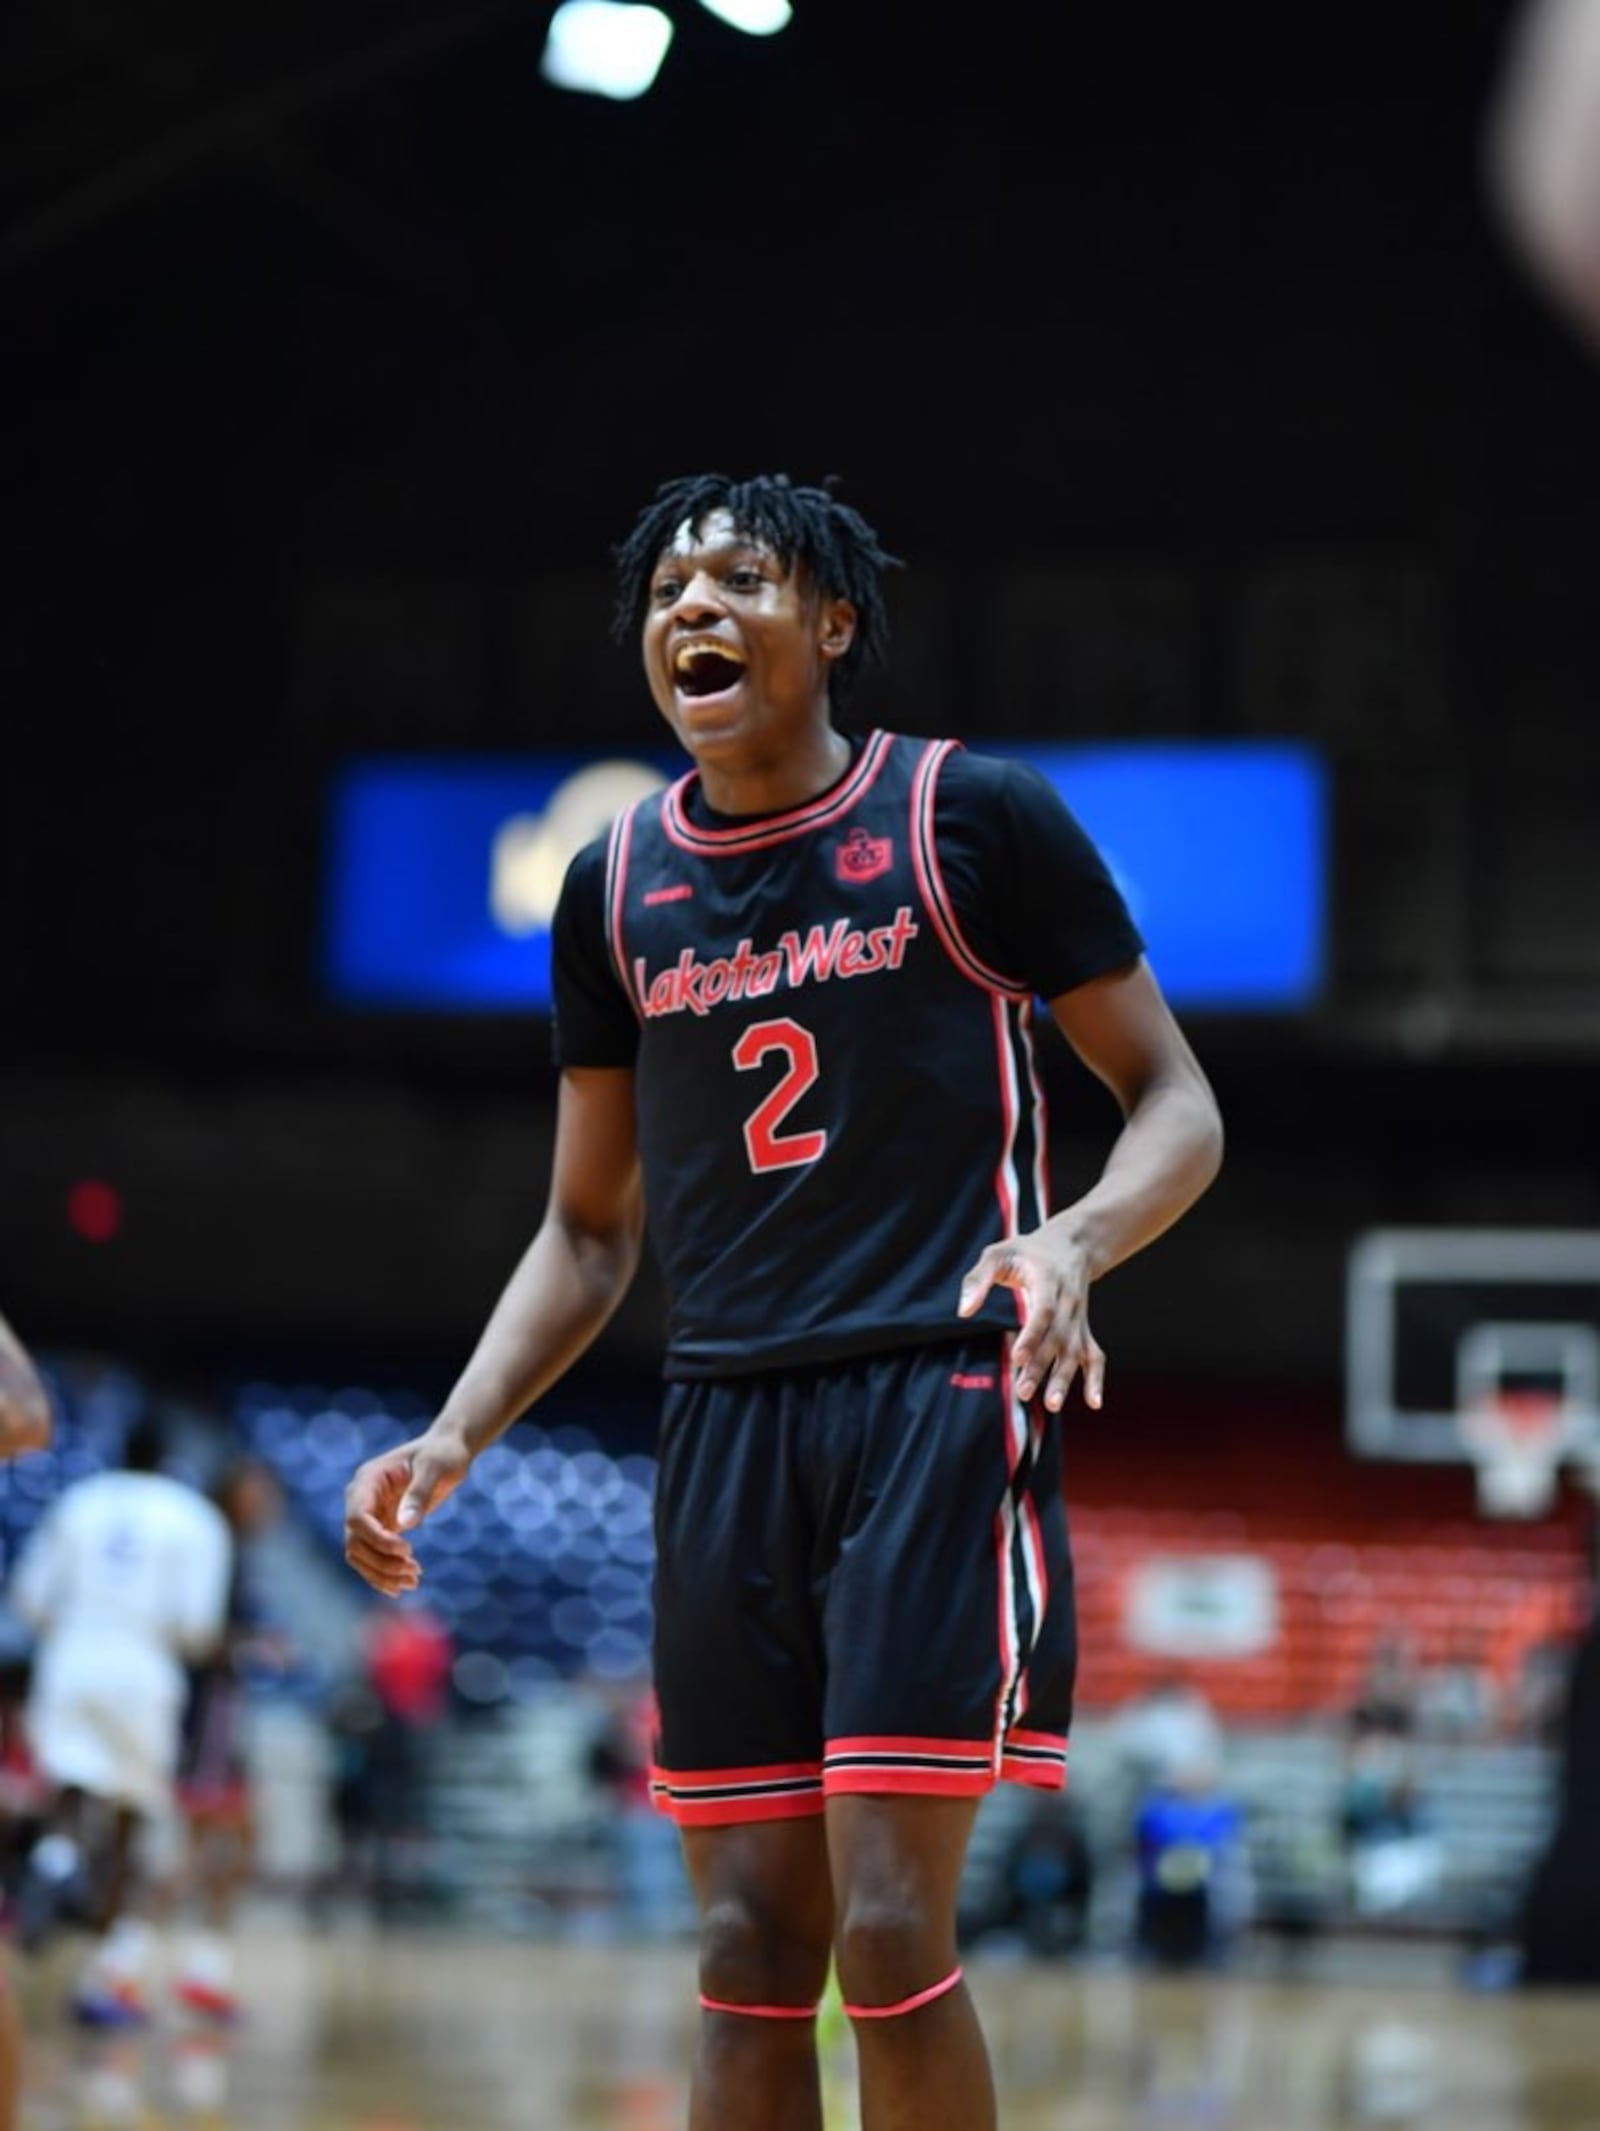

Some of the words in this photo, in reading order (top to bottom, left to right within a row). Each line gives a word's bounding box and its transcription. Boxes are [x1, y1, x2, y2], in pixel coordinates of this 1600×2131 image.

[634, 938, 782, 1018] Lakota
[778, 906, 918, 987] West
[731, 1017, 828, 1174] 2
